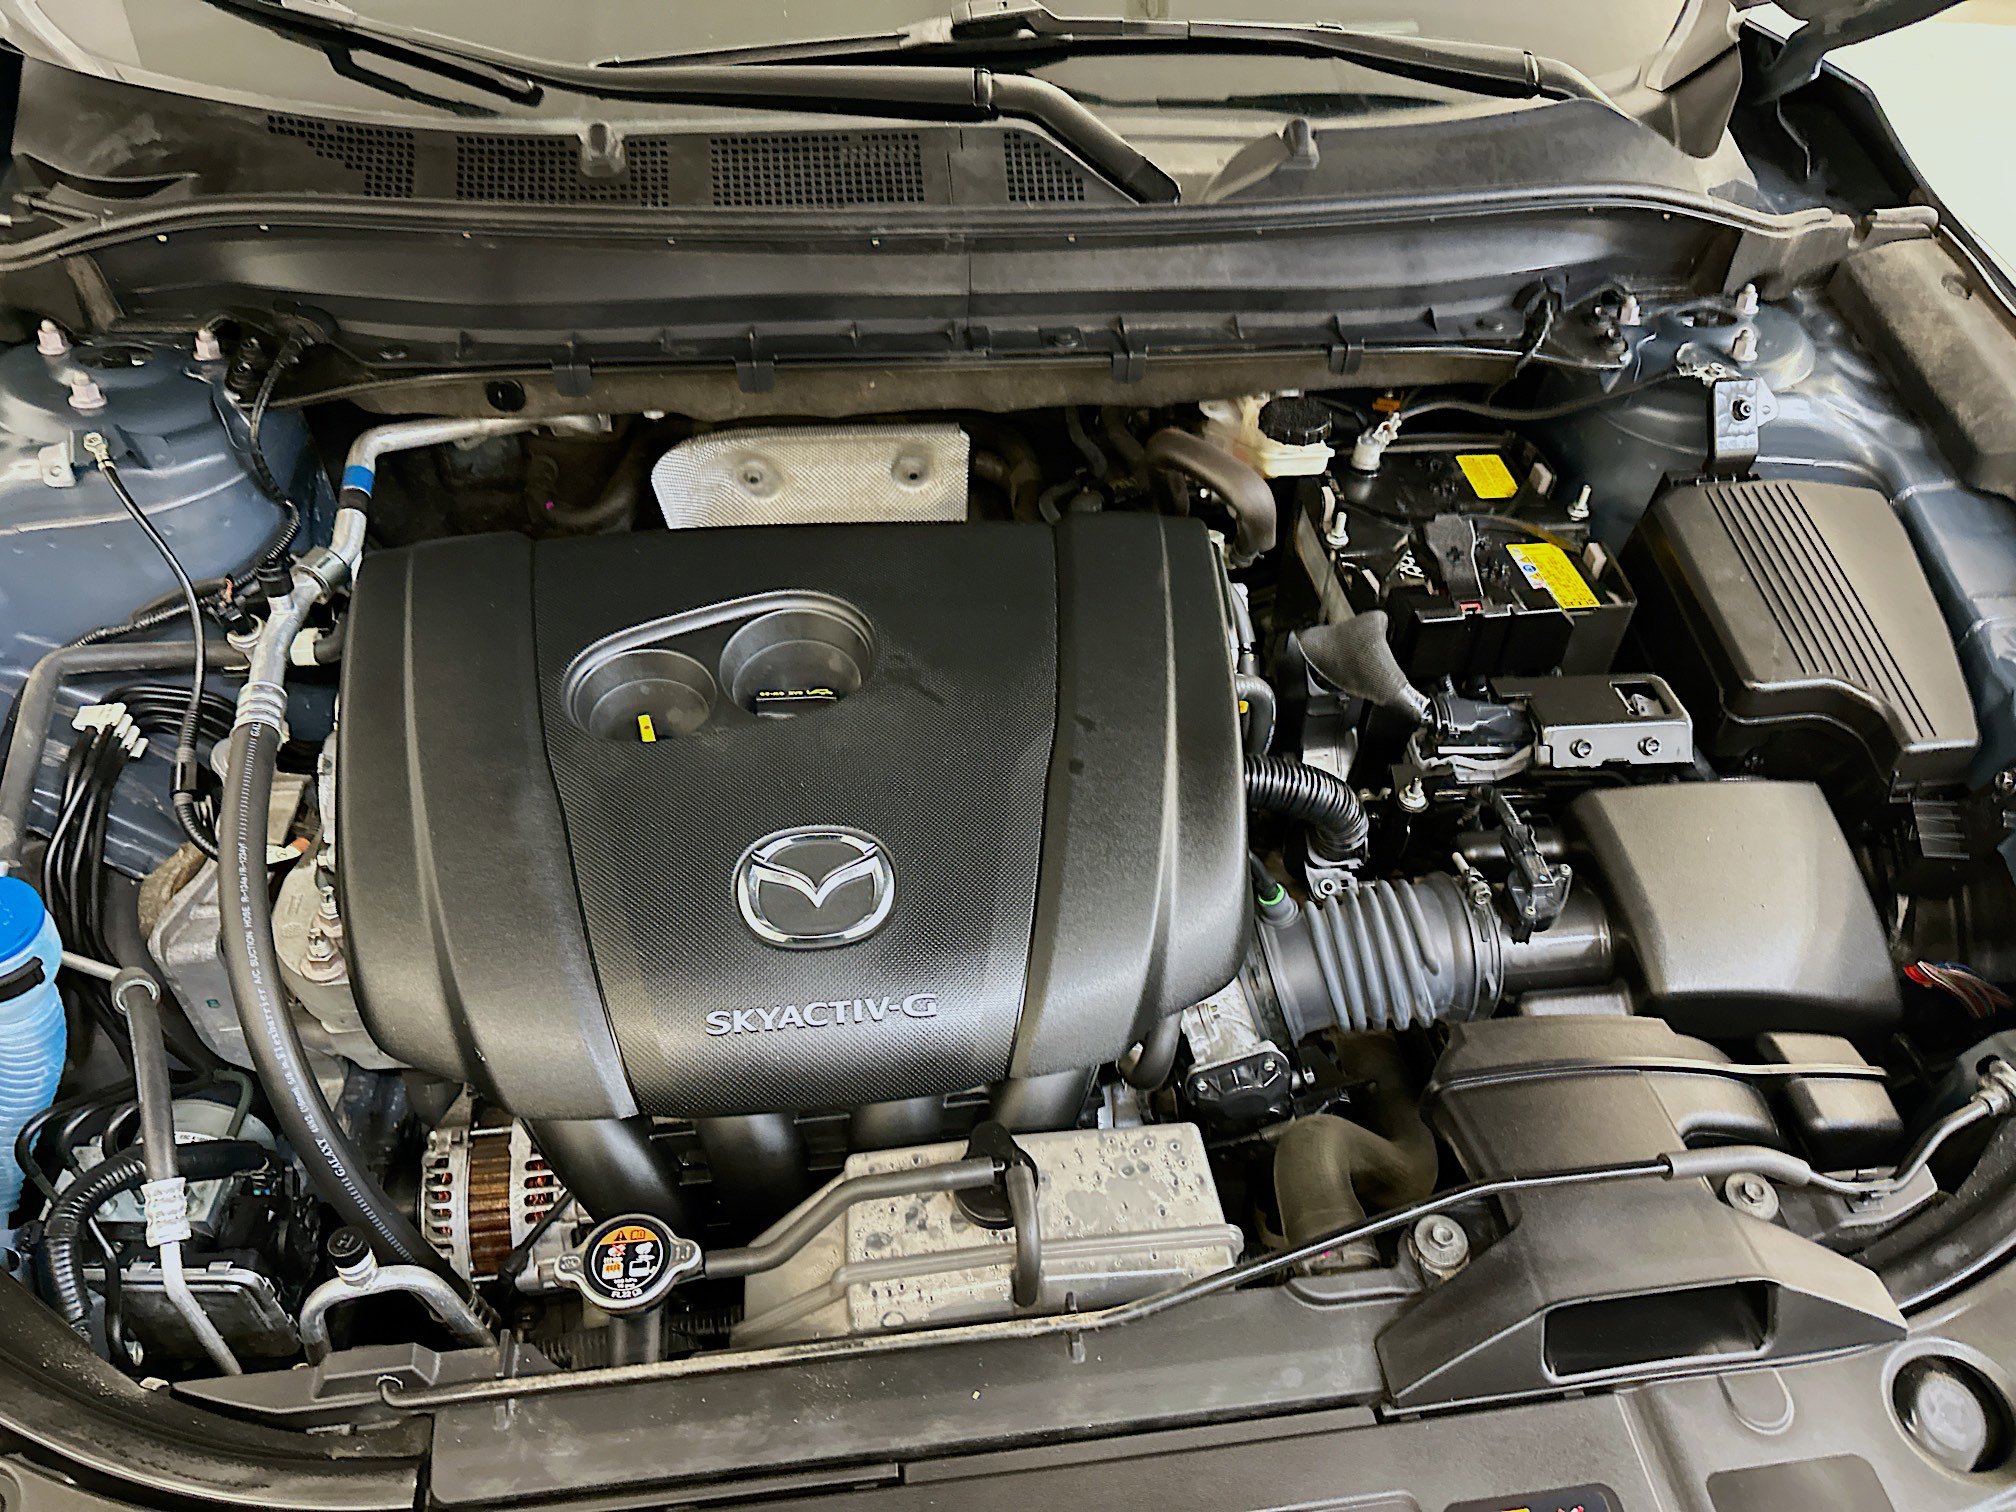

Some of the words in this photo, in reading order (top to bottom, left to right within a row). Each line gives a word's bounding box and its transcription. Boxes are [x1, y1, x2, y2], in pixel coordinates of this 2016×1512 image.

[241, 906, 252, 928] HOSE
[245, 931, 260, 968] SUCTION
[251, 969, 262, 985] A/C
[705, 993, 938, 1036] SKYACTIV-G
[315, 1138, 346, 1177] GALAXY
